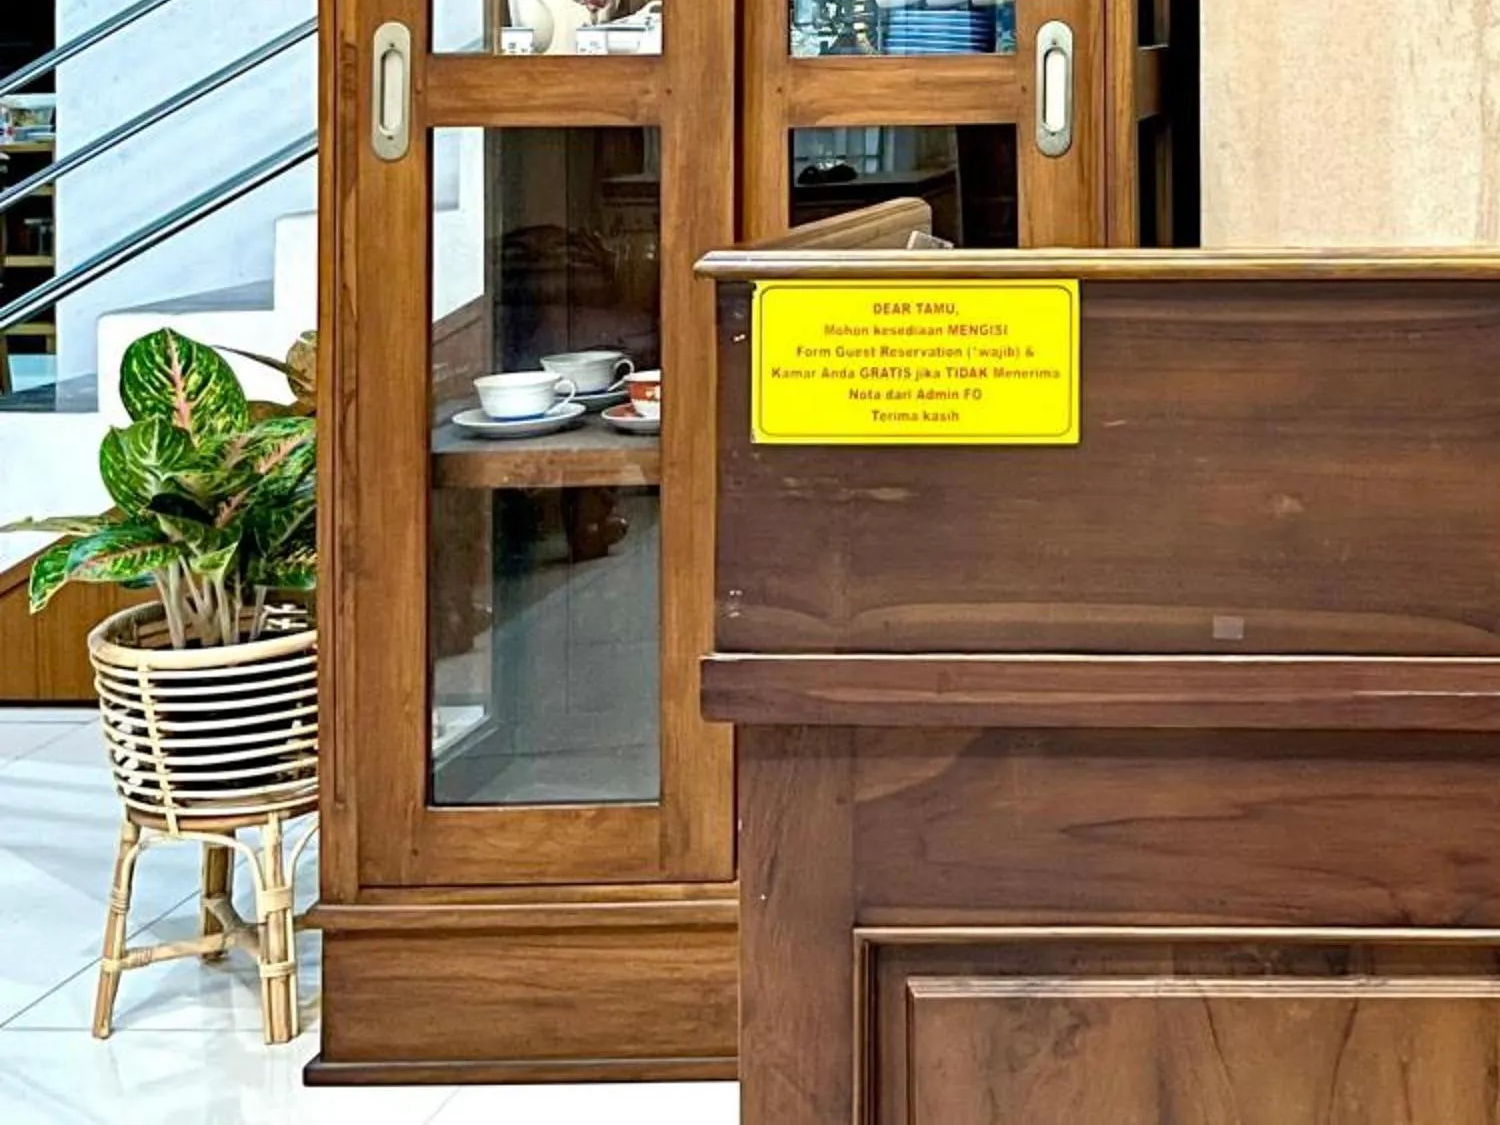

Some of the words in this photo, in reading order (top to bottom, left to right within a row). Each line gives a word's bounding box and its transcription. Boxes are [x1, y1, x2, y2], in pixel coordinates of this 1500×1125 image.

[873, 302, 912, 315] DEAR
[915, 302, 960, 315] TAMU,
[824, 324, 869, 336] Mohon
[873, 324, 944, 336] kesediaan
[947, 324, 1008, 336] MENGISI
[796, 345, 831, 358] Form
[835, 345, 876, 358] Guest
[880, 345, 963, 358] Reservation
[1025, 345, 1035, 358] &
[771, 366, 817, 379] Kamar
[820, 366, 855, 379] Anda
[859, 366, 912, 379] GRATIS
[914, 366, 941, 381] jika
[945, 366, 988, 379] TIDAK
[993, 366, 1061, 379] Menerima
[849, 388, 882, 400] Nota
[885, 388, 913, 400] dari
[916, 388, 960, 400] Admin
[963, 388, 983, 400] FO
[871, 410, 919, 422] Terima
[922, 410, 960, 422] kasih
